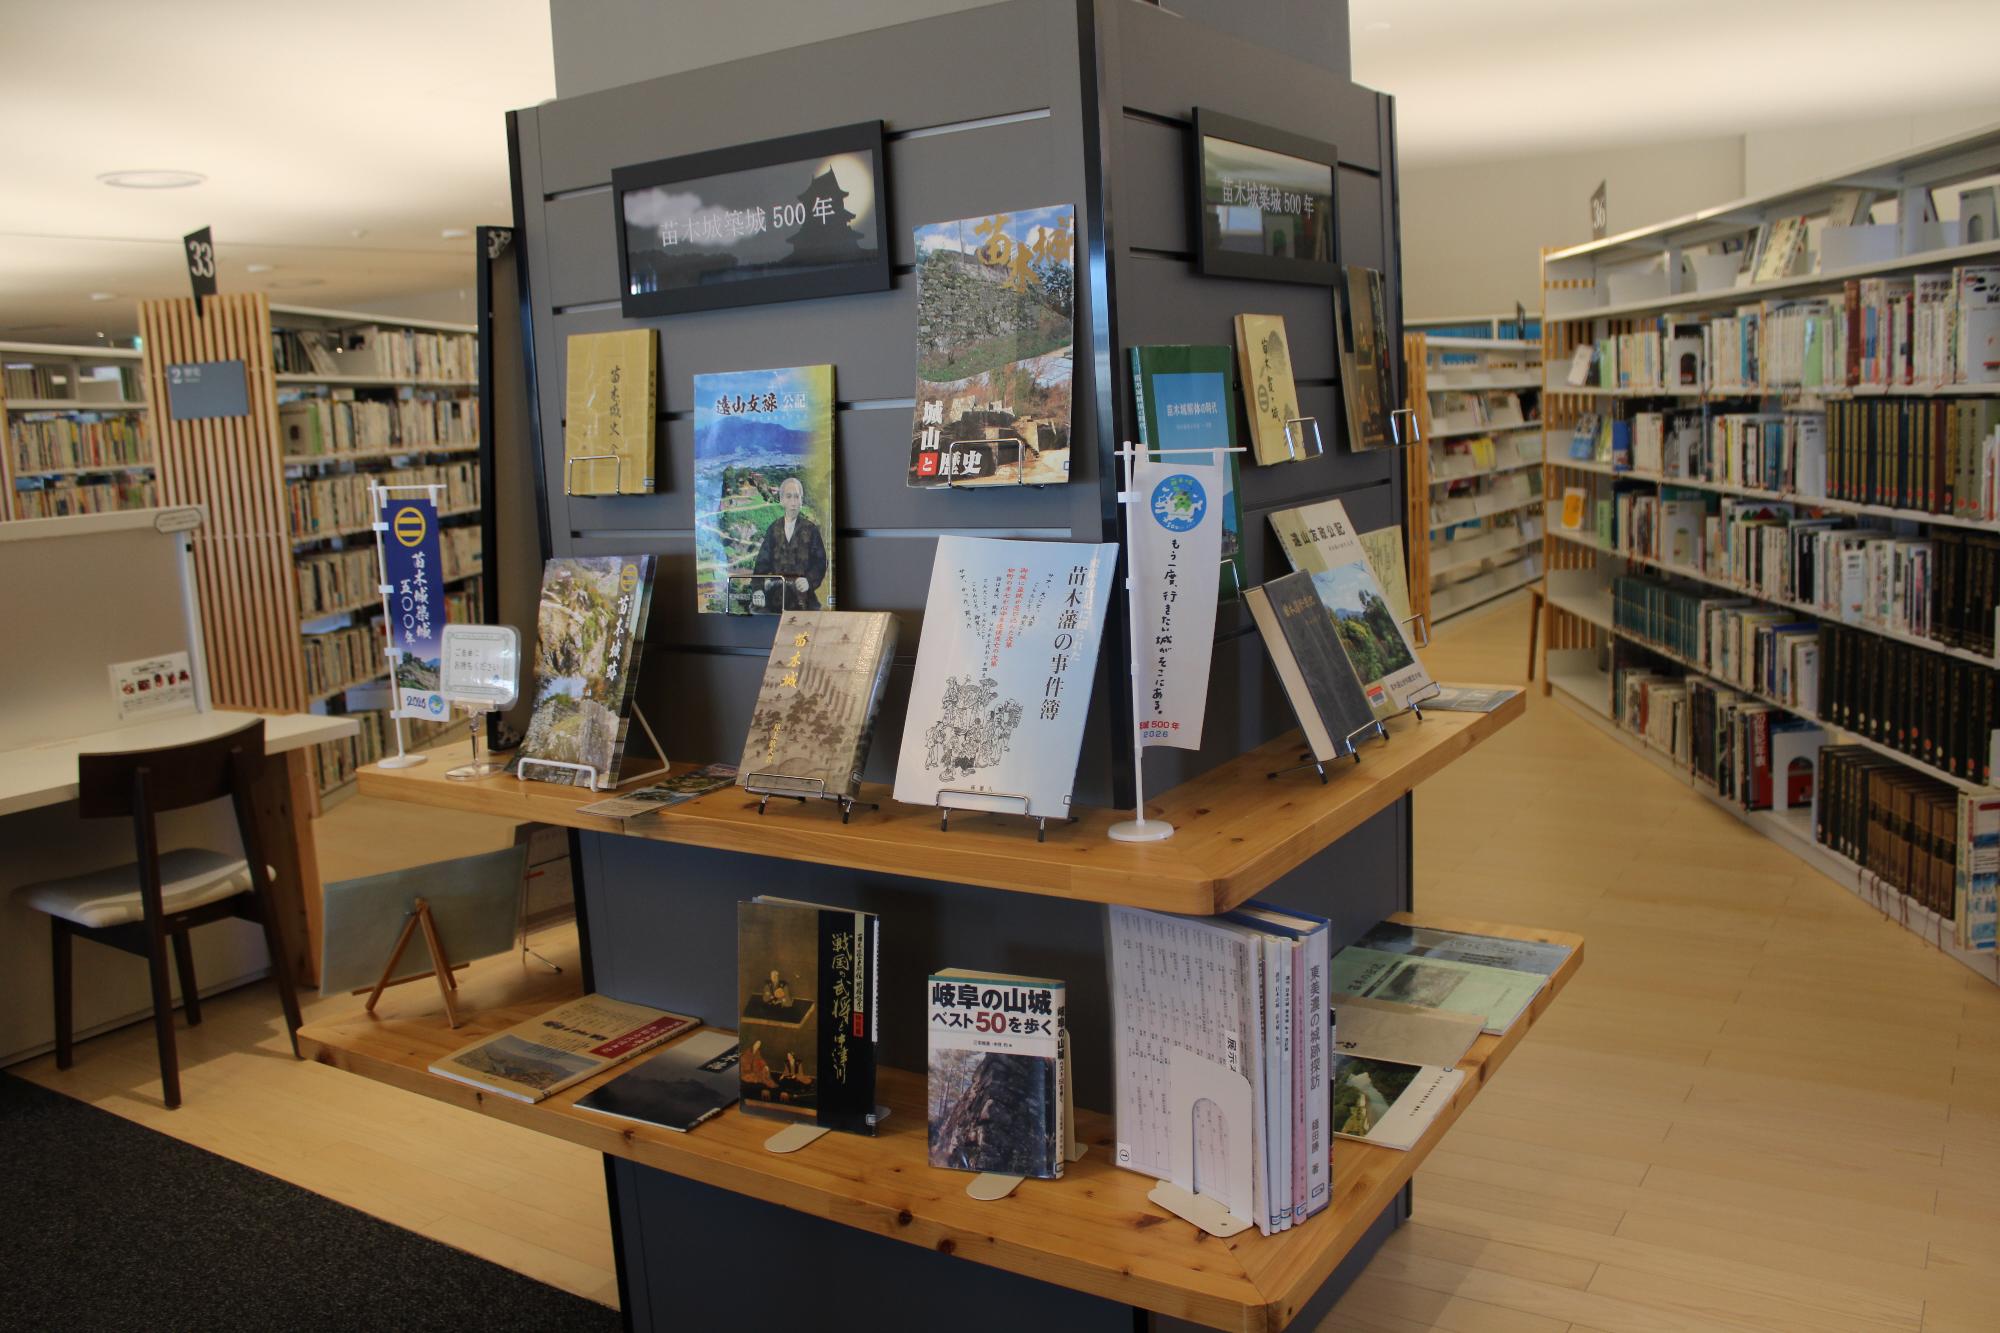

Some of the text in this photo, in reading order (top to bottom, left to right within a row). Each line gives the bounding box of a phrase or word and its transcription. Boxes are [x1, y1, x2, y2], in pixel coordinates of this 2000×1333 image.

[189, 241, 215, 278] 33
[411, 551, 432, 640] 苗木城築城
[1039, 565, 1089, 721] 苗木藩の事件簿
[932, 982, 1053, 1016] 岐阜の山城
[931, 1012, 1053, 1036] ベスト50を歩く
